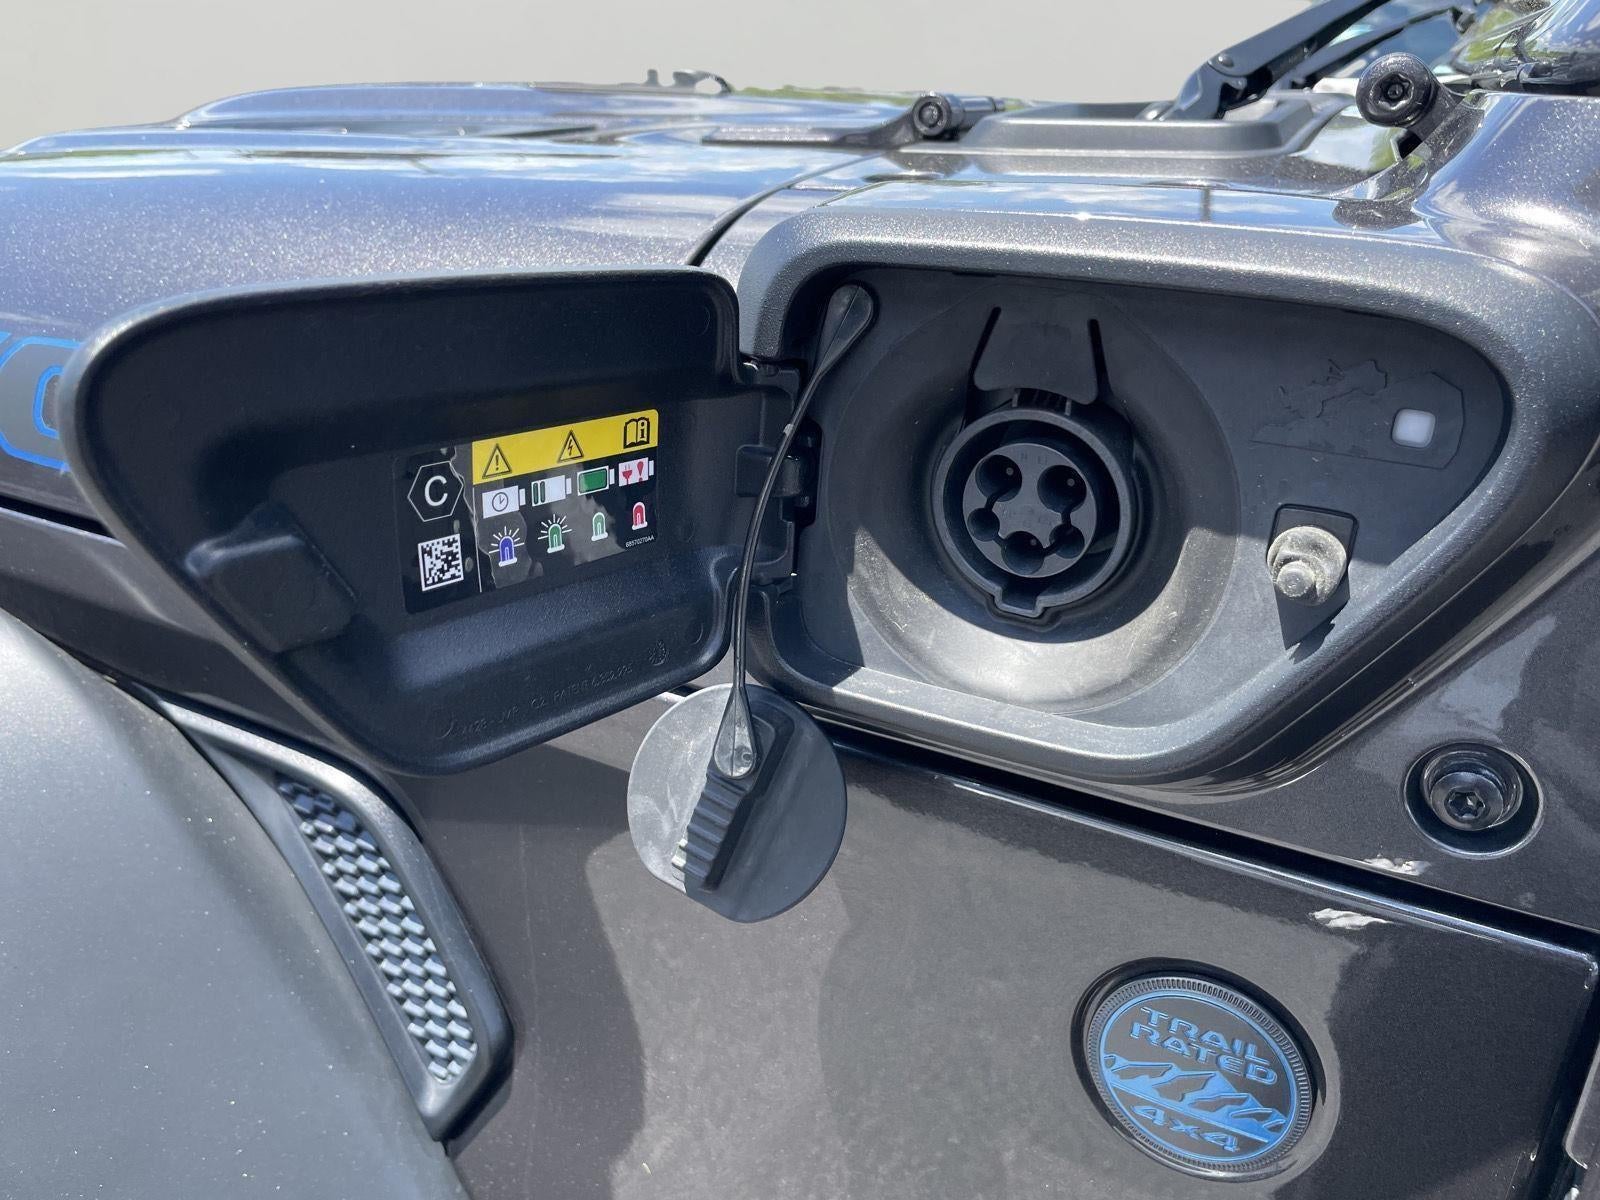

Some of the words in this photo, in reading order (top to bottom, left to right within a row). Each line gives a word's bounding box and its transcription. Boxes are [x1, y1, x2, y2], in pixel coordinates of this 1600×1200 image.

[424, 475, 448, 507] C
[1130, 1022, 1278, 1085] RATED
[1140, 1006, 1271, 1066] TRAIL
